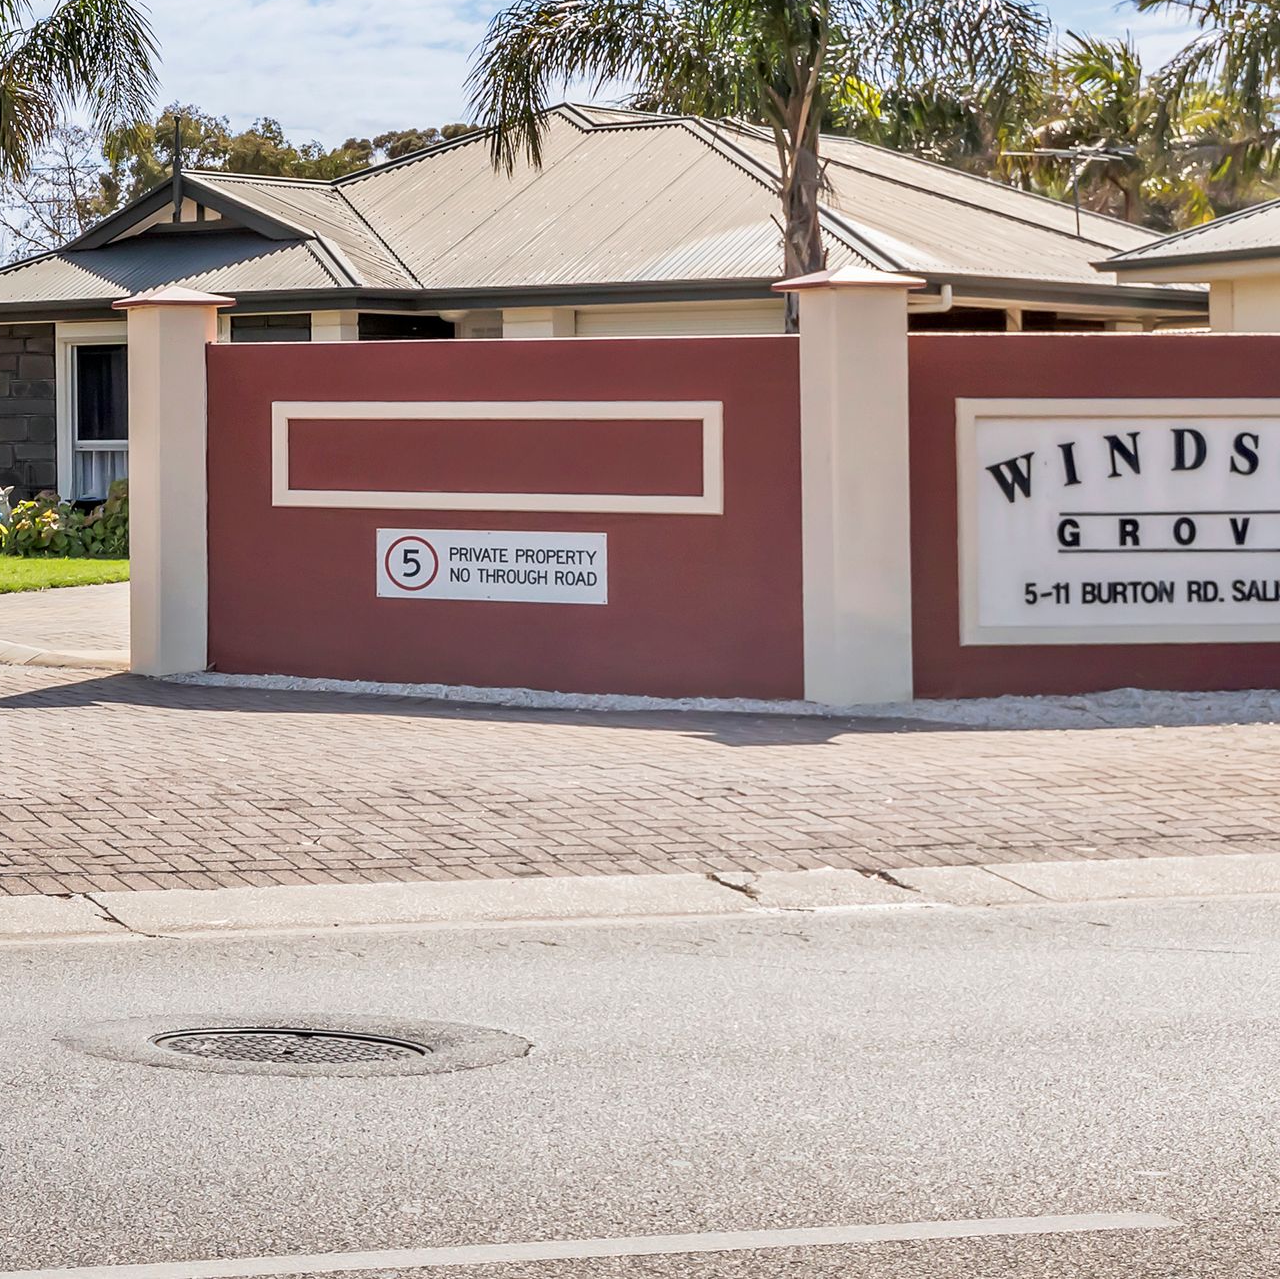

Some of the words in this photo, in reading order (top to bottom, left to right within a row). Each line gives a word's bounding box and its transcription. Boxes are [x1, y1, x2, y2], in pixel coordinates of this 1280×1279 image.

[985, 428, 1280, 504] WINDS
[1056, 517, 1251, 547] GROV
[402, 549, 422, 578] 5
[449, 547, 509, 563] PRIVATE
[515, 549, 597, 566] PROPERTY
[449, 568, 471, 583] NO
[477, 569, 548, 585] THROUGH
[554, 571, 598, 587] ROAD
[1024, 582, 1070, 606] 5-11
[1081, 581, 1175, 604] BURTON
[1186, 580, 1225, 603] RD.
[1231, 579, 1280, 602] SALI
